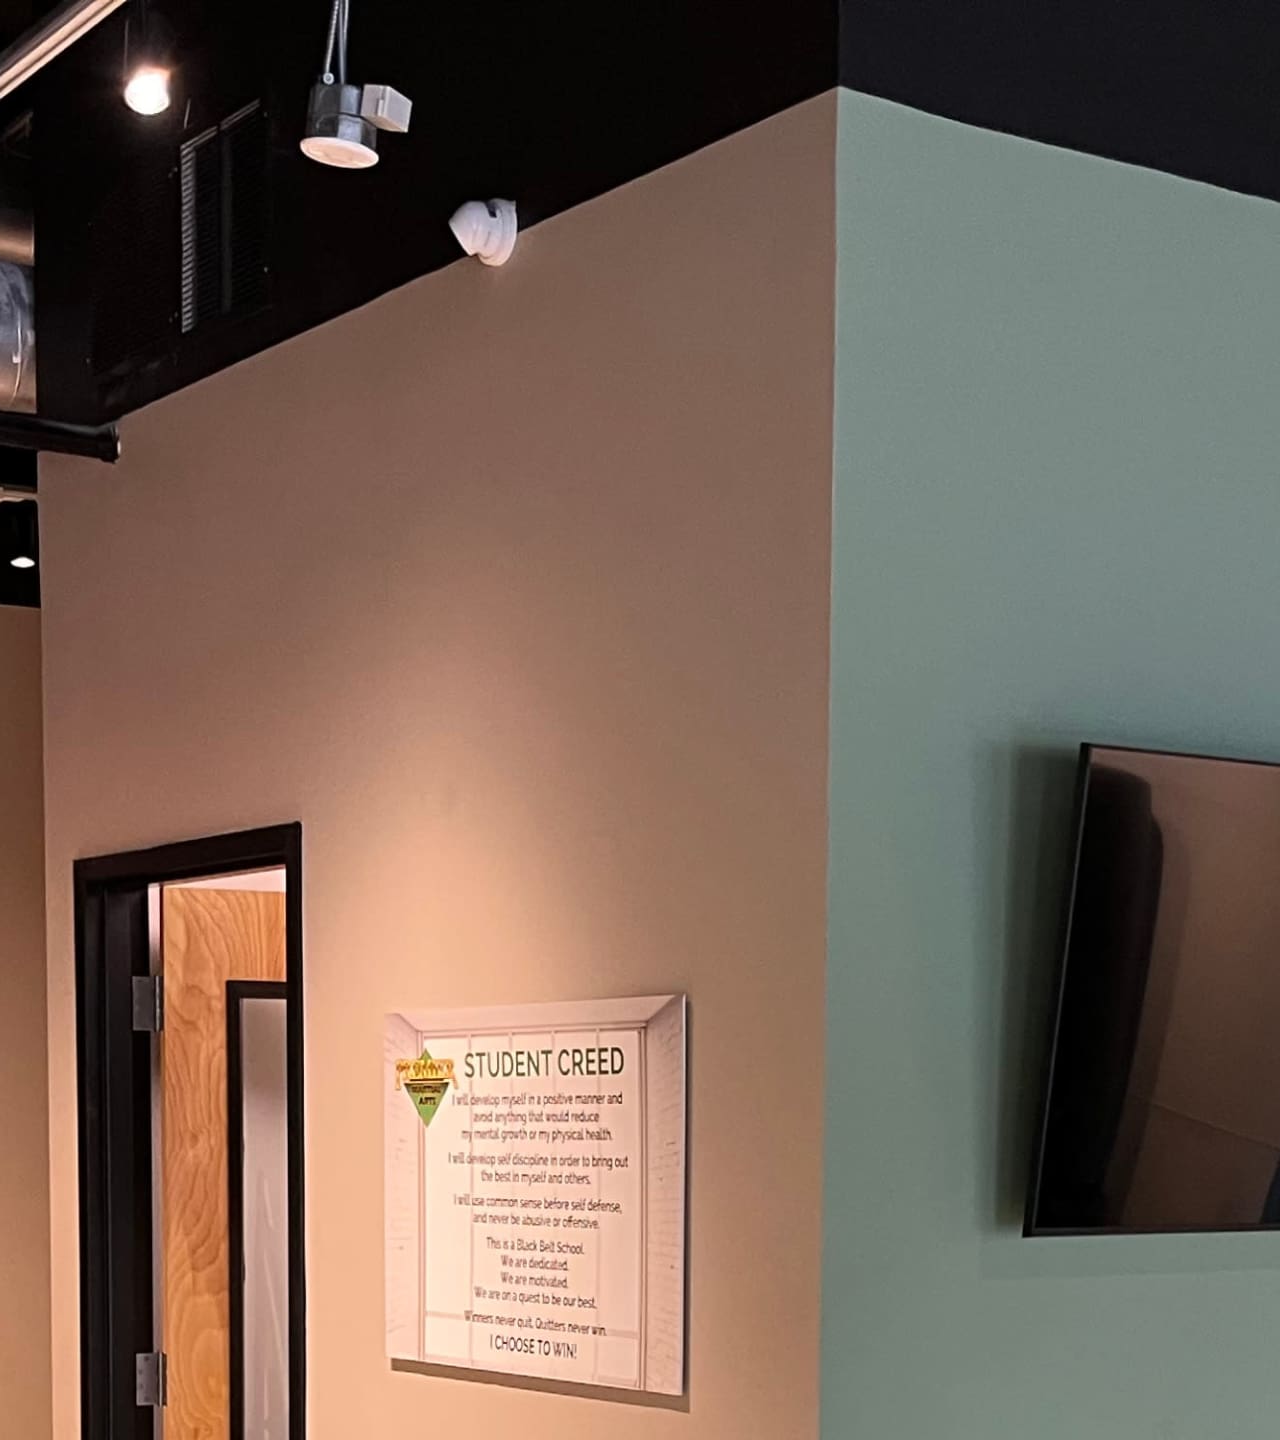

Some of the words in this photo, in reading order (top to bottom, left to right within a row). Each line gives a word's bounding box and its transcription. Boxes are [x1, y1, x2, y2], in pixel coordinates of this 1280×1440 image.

[463, 1050, 554, 1079] STUDENT
[557, 1046, 625, 1076] CREED
[502, 1092, 526, 1108] myself
[544, 1093, 573, 1108] positive
[575, 1095, 605, 1104] manner
[607, 1091, 622, 1104] and
[546, 1109, 569, 1122] would
[571, 1110, 600, 1122] reduce
[552, 1128, 584, 1144] physical
[497, 1153, 511, 1165] self
[512, 1153, 548, 1167] discipline
[559, 1154, 580, 1166] order
[582, 1156, 590, 1167] to
[592, 1155, 613, 1171] bring
[615, 1156, 628, 1168] out
[495, 1170, 511, 1182] best
[521, 1171, 546, 1187] myself
[548, 1172, 562, 1183] and
[544, 1197, 569, 1210] before
[571, 1198, 586, 1211] self
[500, 1255, 514, 1267] We
[515, 1258, 527, 1268] are
[500, 1271, 513, 1284] We
[515, 1275, 527, 1285] are
[519, 1292, 541, 1306] quest
[542, 1294, 550, 1304] to
[551, 1292, 561, 1305] be
[563, 1296, 576, 1306] our
[495, 1335, 535, 1354] CHOOSE
[537, 1340, 551, 1356] TO
[553, 1341, 577, 1360] WIN!
